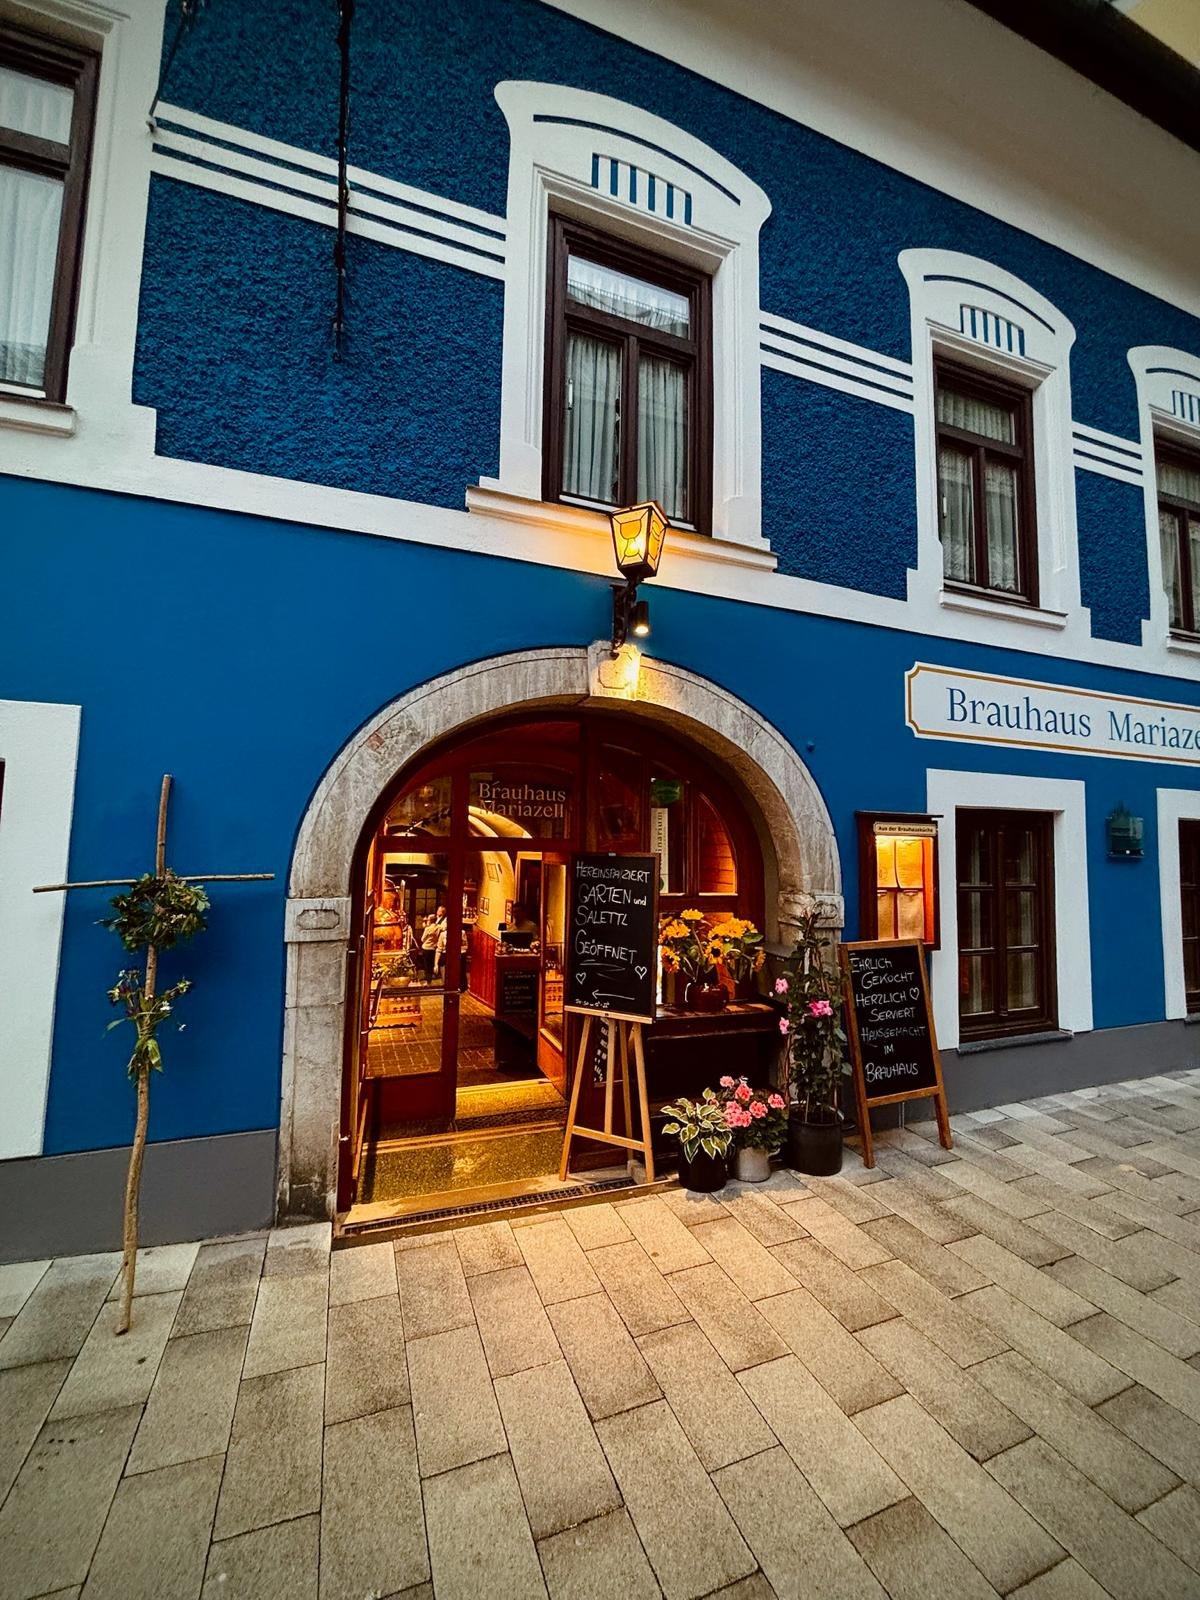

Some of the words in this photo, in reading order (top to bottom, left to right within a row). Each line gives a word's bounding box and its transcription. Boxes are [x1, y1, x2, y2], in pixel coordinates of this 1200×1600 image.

[946, 687, 1092, 737] Brauhaus
[479, 782, 566, 802] Brauhaus
[479, 799, 564, 818] Mariazell
[579, 883, 632, 906] GARTEN
[633, 896, 647, 906] und
[575, 905, 628, 926] SALETTL
[575, 929, 638, 964] GEÖFFNET
[861, 971, 915, 989] GEKOCHT
[855, 991, 907, 1008] HERZLICH
[868, 1007, 917, 1022] SERVIERT
[883, 1043, 895, 1056] IM
[864, 1062, 919, 1083] BRAUHAUS
